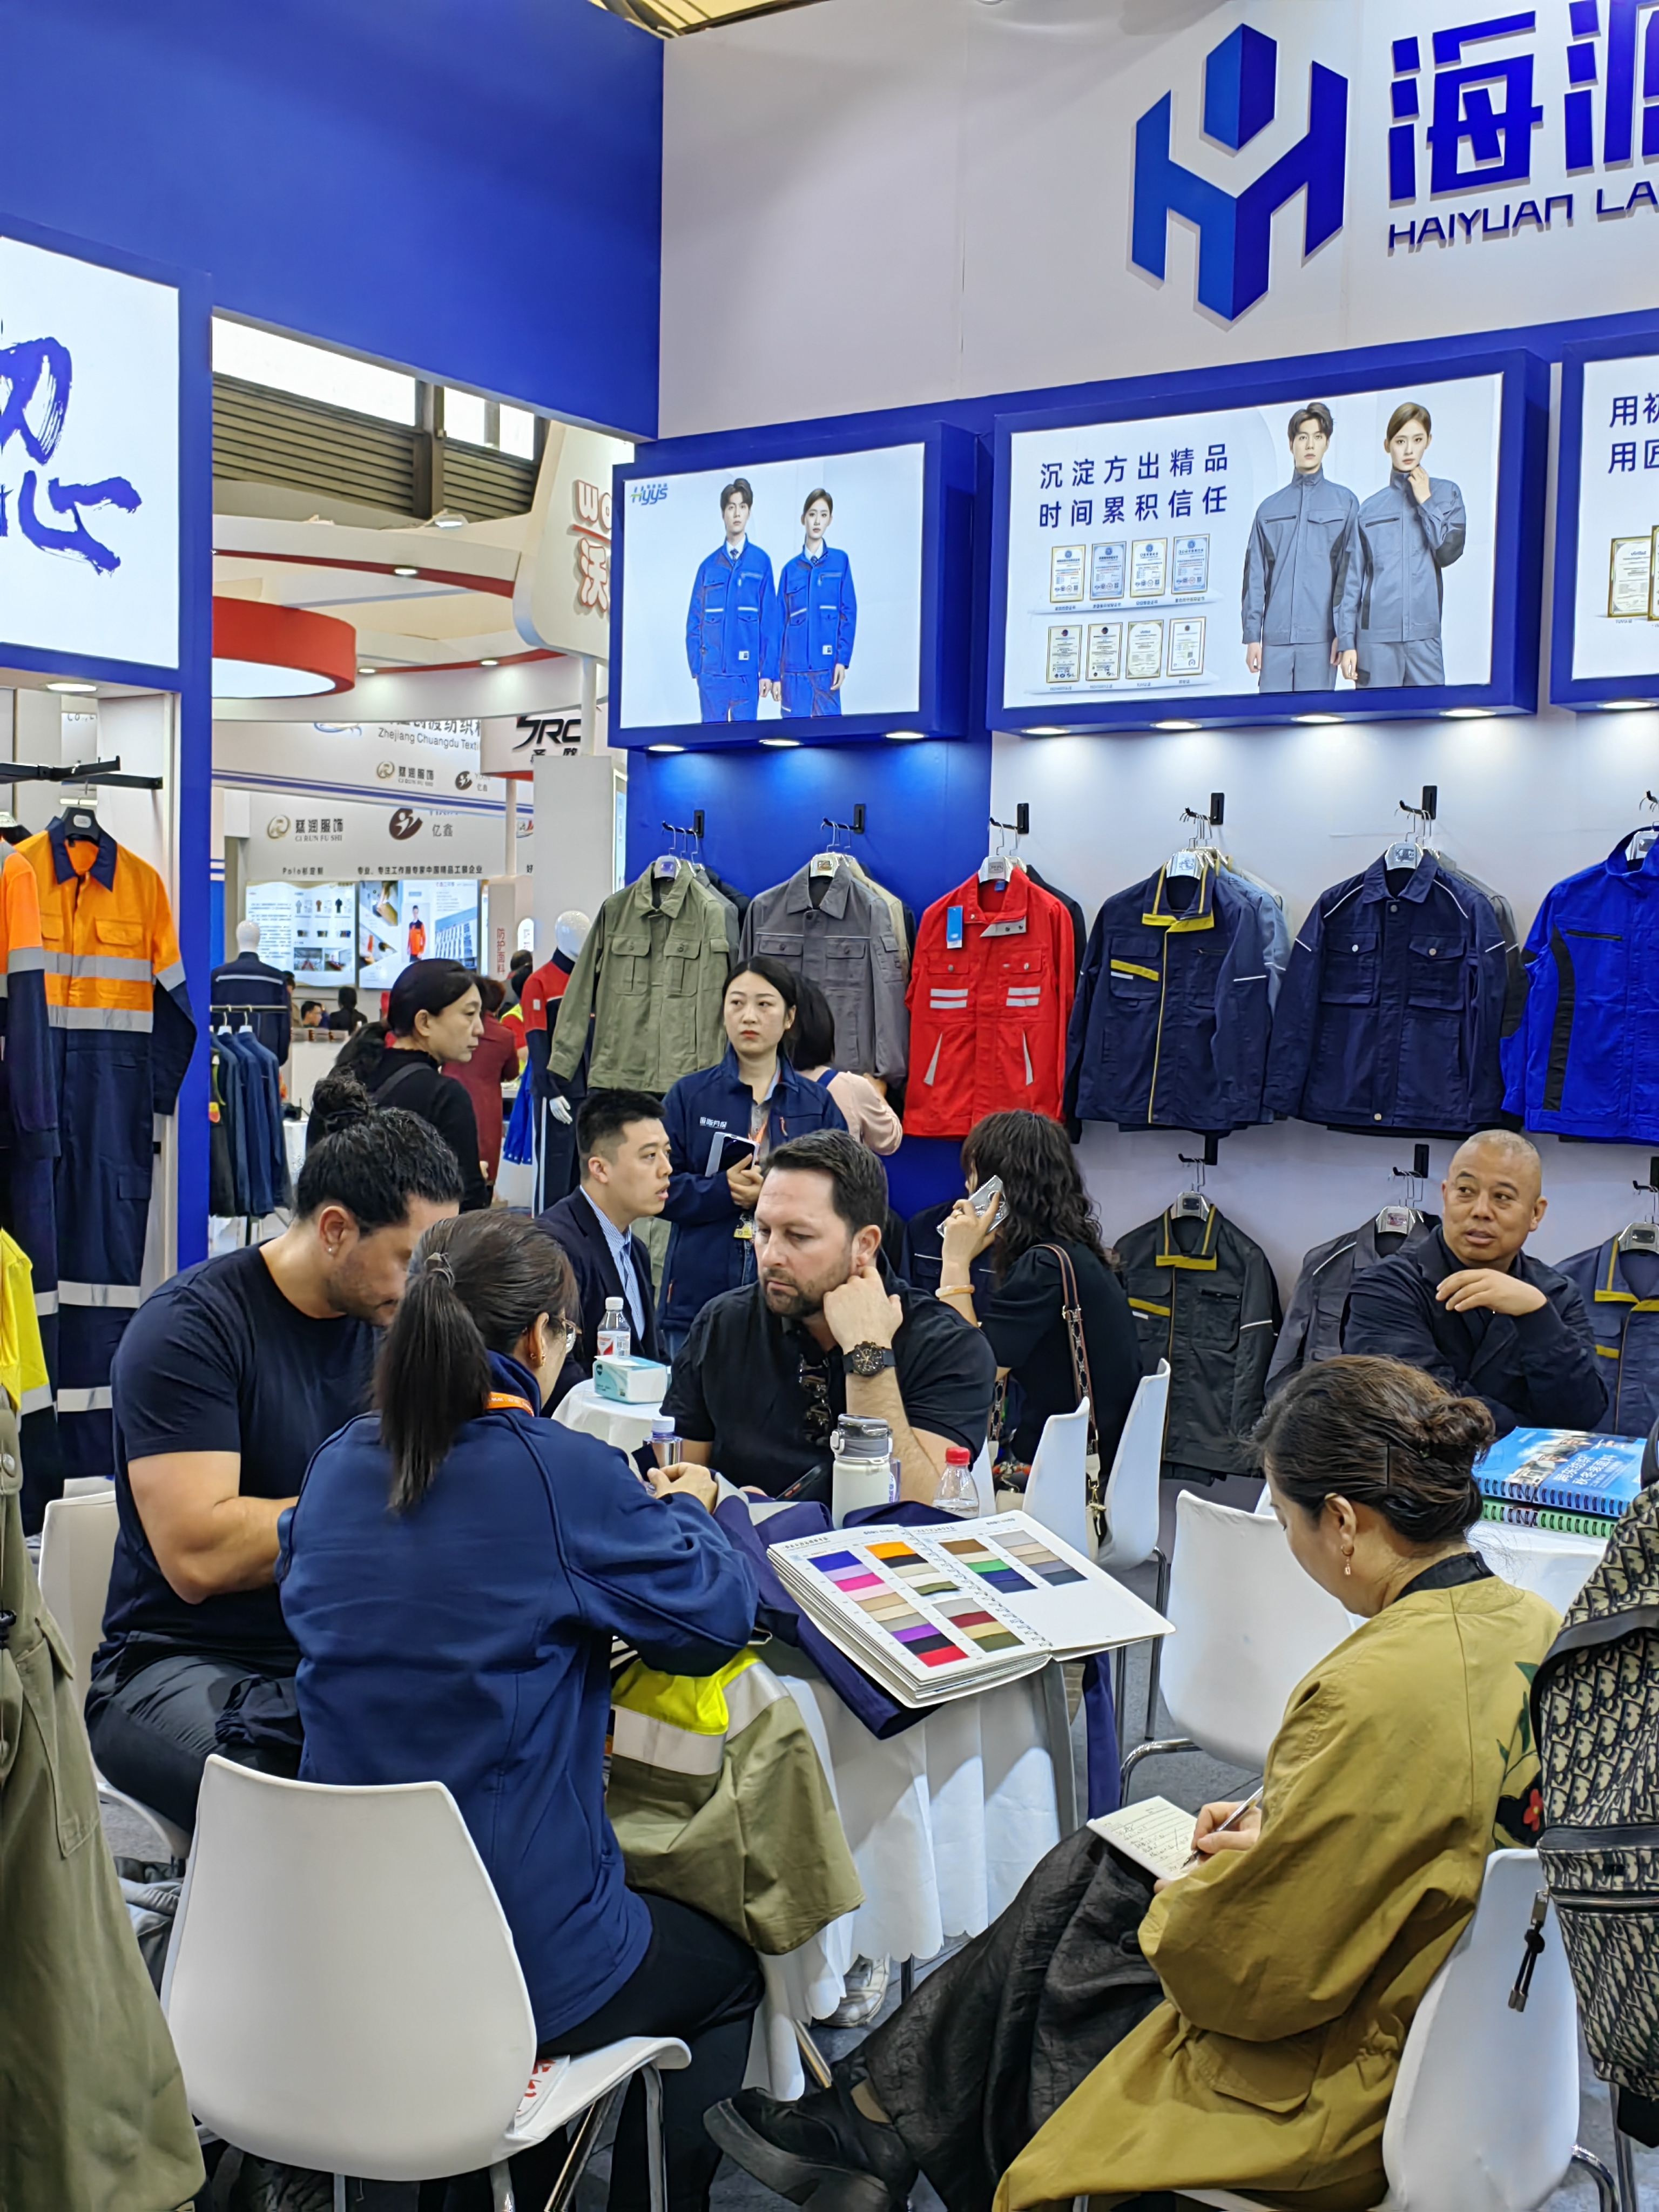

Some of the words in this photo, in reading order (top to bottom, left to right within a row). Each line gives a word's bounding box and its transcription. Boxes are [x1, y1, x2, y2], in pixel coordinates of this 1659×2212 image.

[1040, 443, 1228, 490] 沉淀方出精品
[1039, 485, 1228, 528] 时间累积信任
[378, 727, 415, 744] Zhejiang
[417, 733, 459, 749] Chuangdu
[433, 824, 453, 837] 亿鑫
